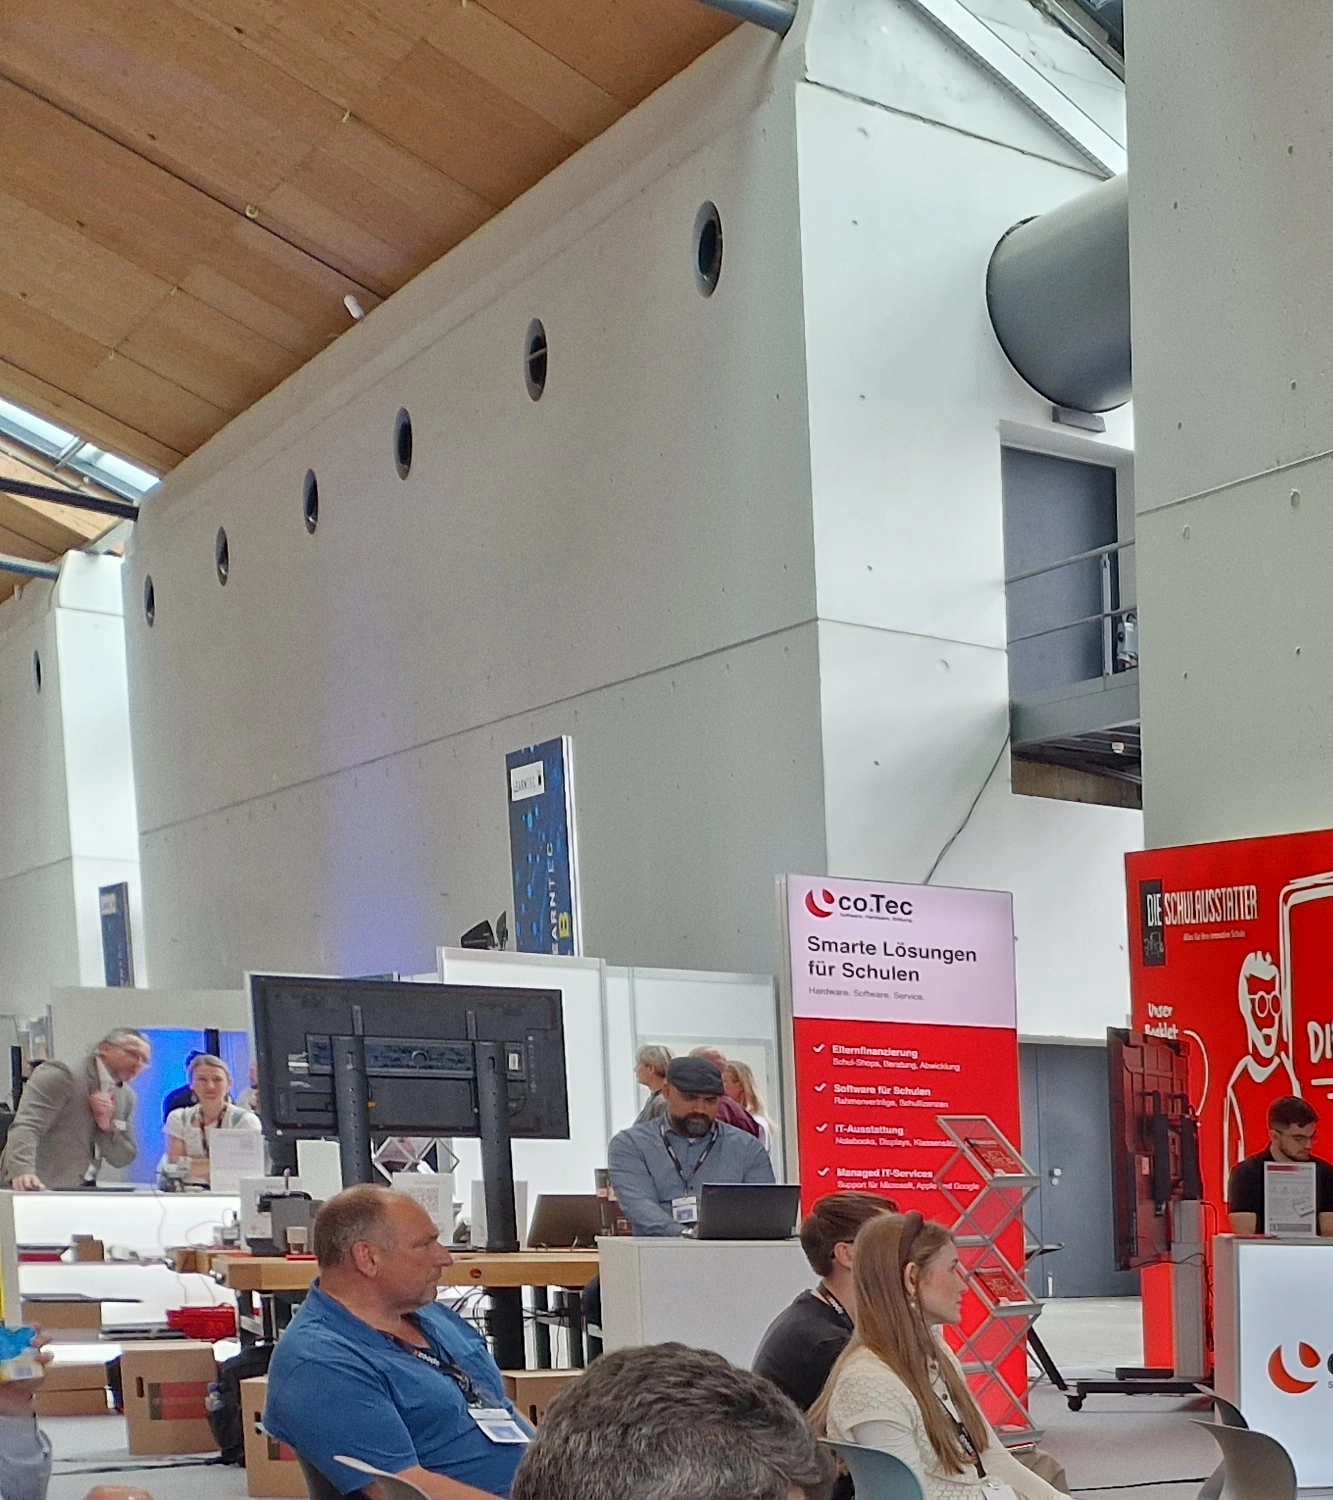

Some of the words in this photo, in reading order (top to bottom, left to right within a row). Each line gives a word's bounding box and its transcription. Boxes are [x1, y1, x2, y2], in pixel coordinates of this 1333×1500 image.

[546, 843, 559, 955] EARNTEC
[838, 893, 914, 916] co.Tec
[1146, 893, 1162, 927] DIE
[1164, 884, 1258, 926] SCHULAUSSTATTER
[807, 935, 877, 956] Smarte
[883, 941, 977, 964] Lösungen
[808, 960, 835, 977] für
[842, 962, 920, 982] Schulen
[808, 986, 850, 997] Hardware.
[853, 988, 890, 999] Software.
[833, 1083, 876, 1095] Software
[878, 1085, 891, 1095] für
[893, 1085, 931, 1097] Schulen
[834, 1123, 905, 1136] IT-Ausstattung
[836, 1167, 880, 1179] Managed
[881, 1168, 933, 1179] IT-Services
